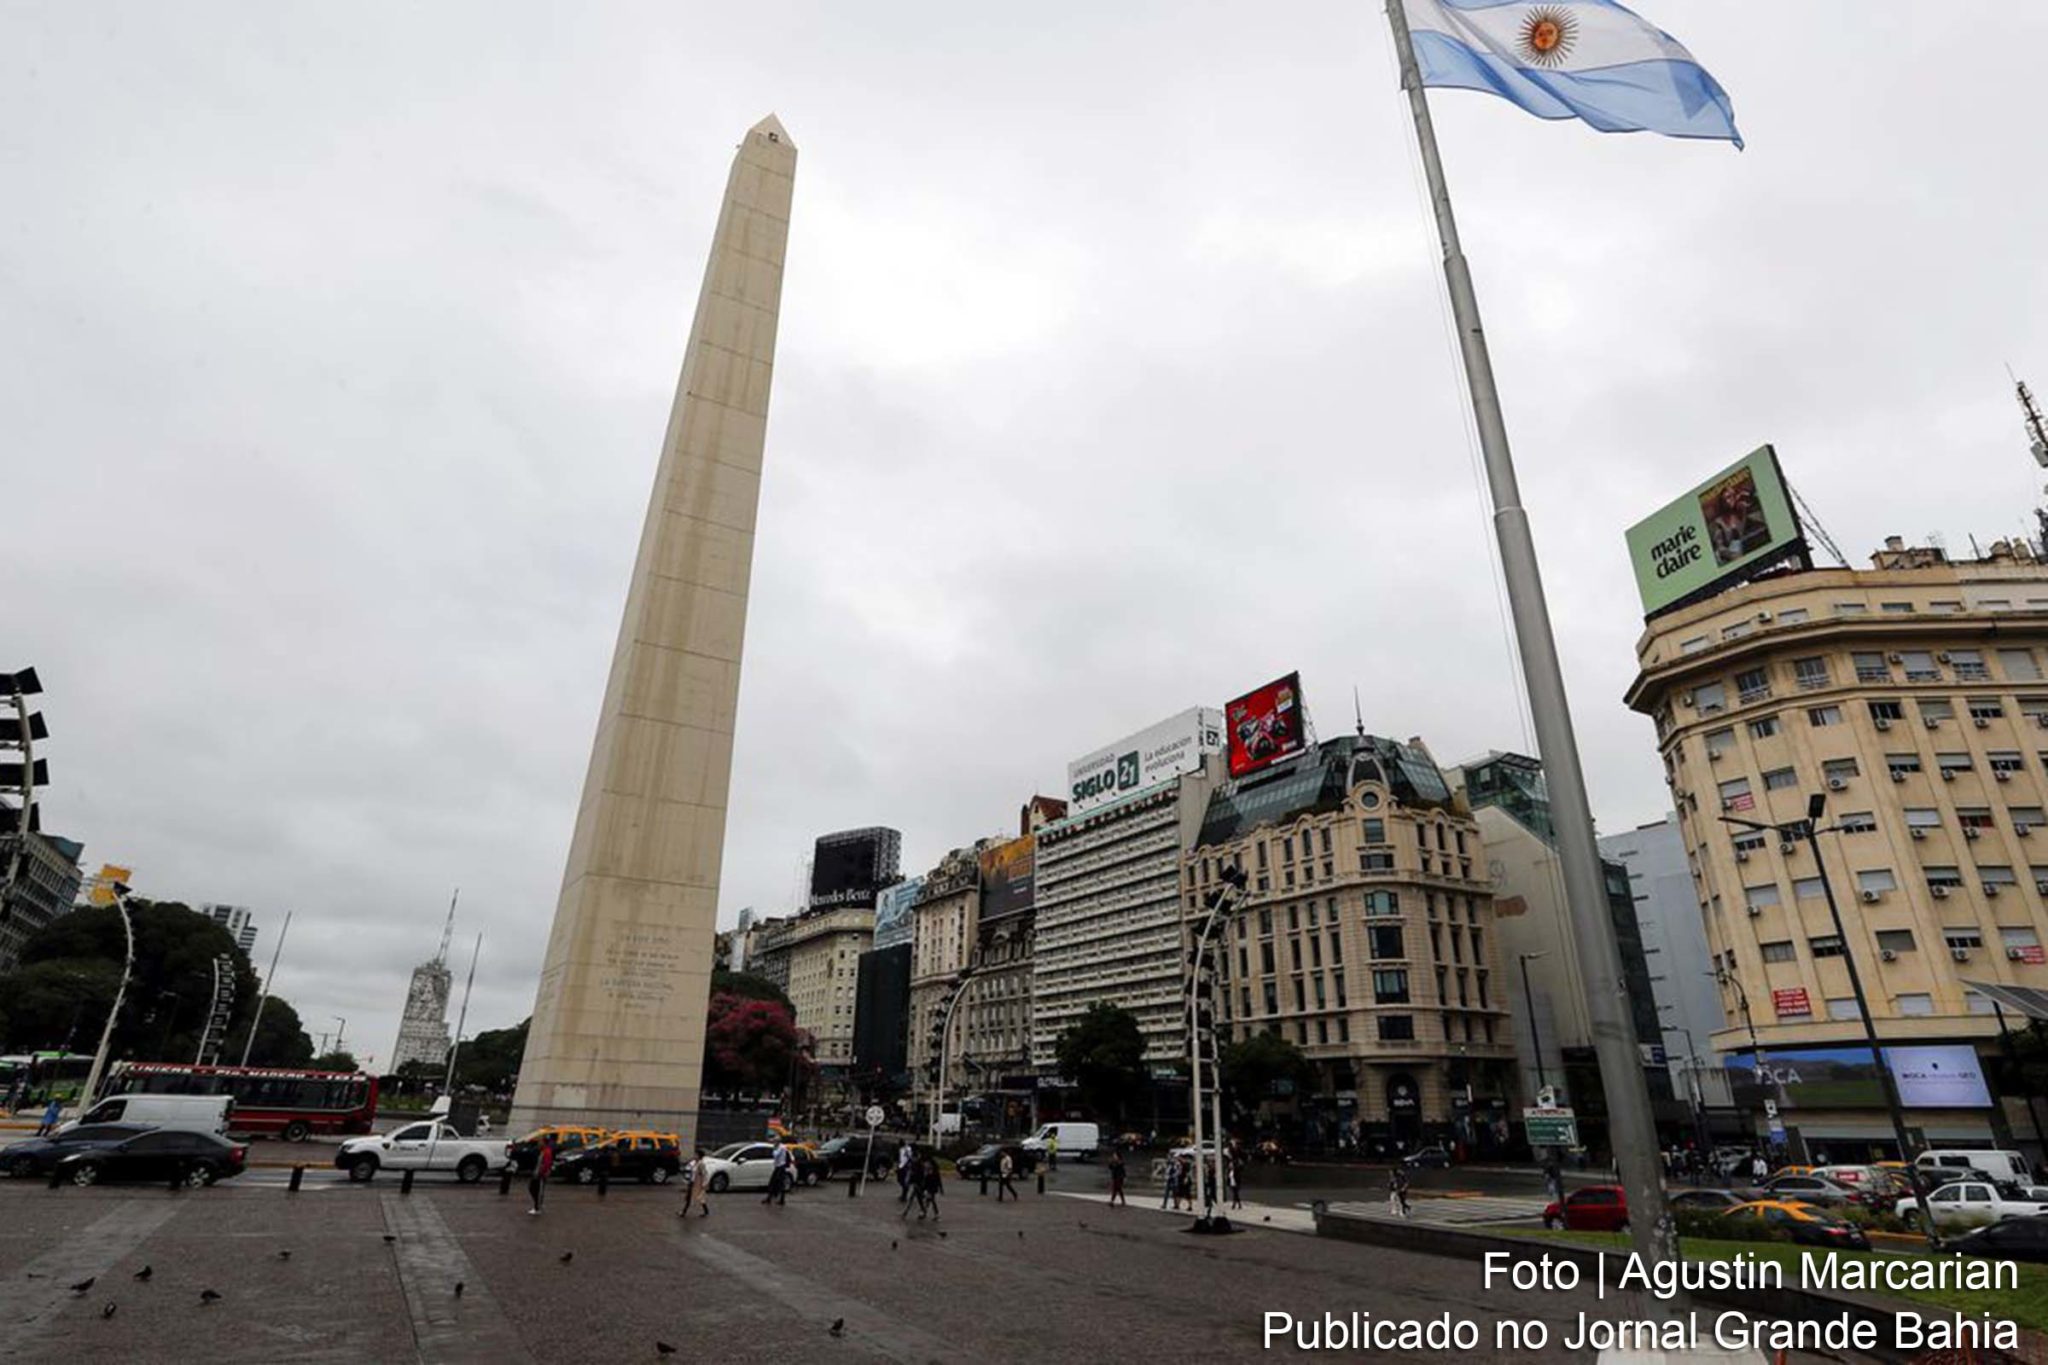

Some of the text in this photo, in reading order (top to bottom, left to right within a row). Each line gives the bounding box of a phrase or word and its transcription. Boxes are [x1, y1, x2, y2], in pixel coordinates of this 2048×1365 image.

[1650, 525, 1696, 561] marie
[1656, 543, 1702, 580] claire
[1145, 750, 1185, 773] evoluciona
[1072, 769, 1115, 803] SIGLO
[846, 888, 871, 902] Benz
